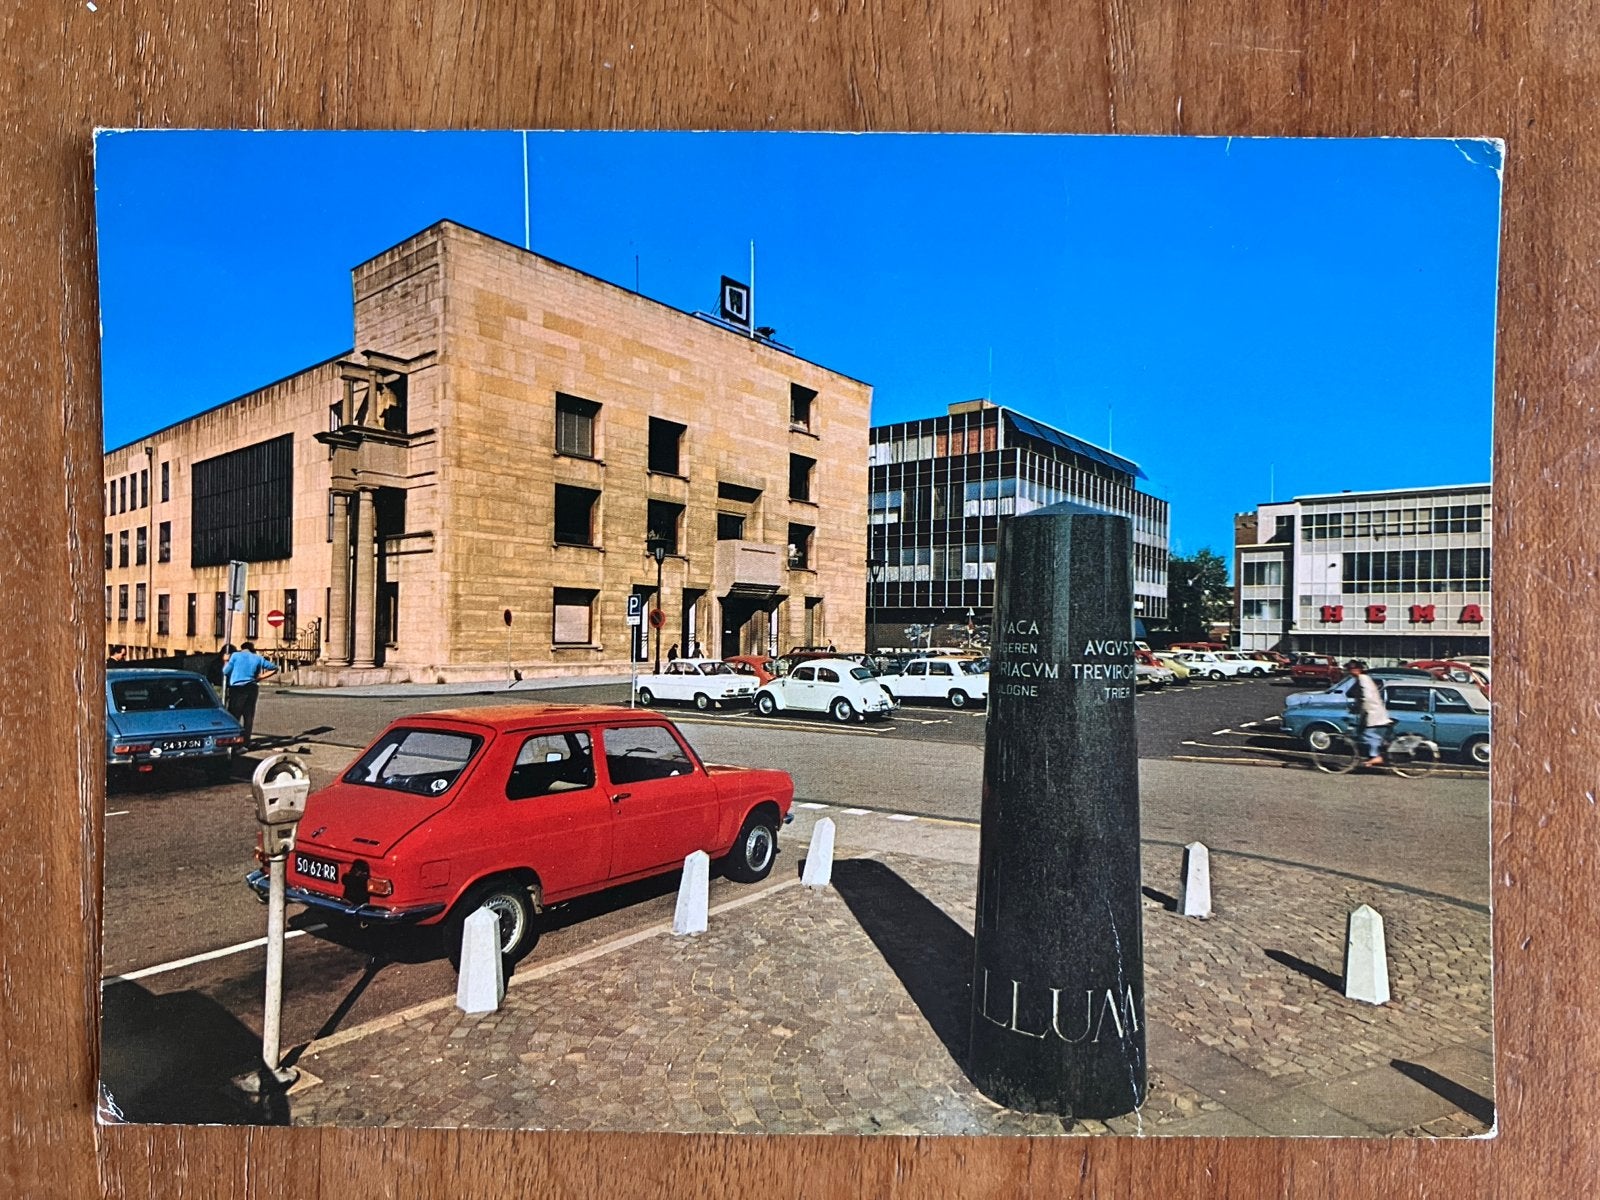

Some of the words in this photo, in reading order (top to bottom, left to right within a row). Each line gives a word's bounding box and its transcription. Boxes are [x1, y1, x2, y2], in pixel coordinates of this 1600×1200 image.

[629, 596, 640, 609] P
[1320, 604, 1483, 624] HEMA
[999, 642, 1038, 654] GEREN
[997, 683, 1039, 697] LOGNE
[1104, 687, 1131, 699] TRIER
